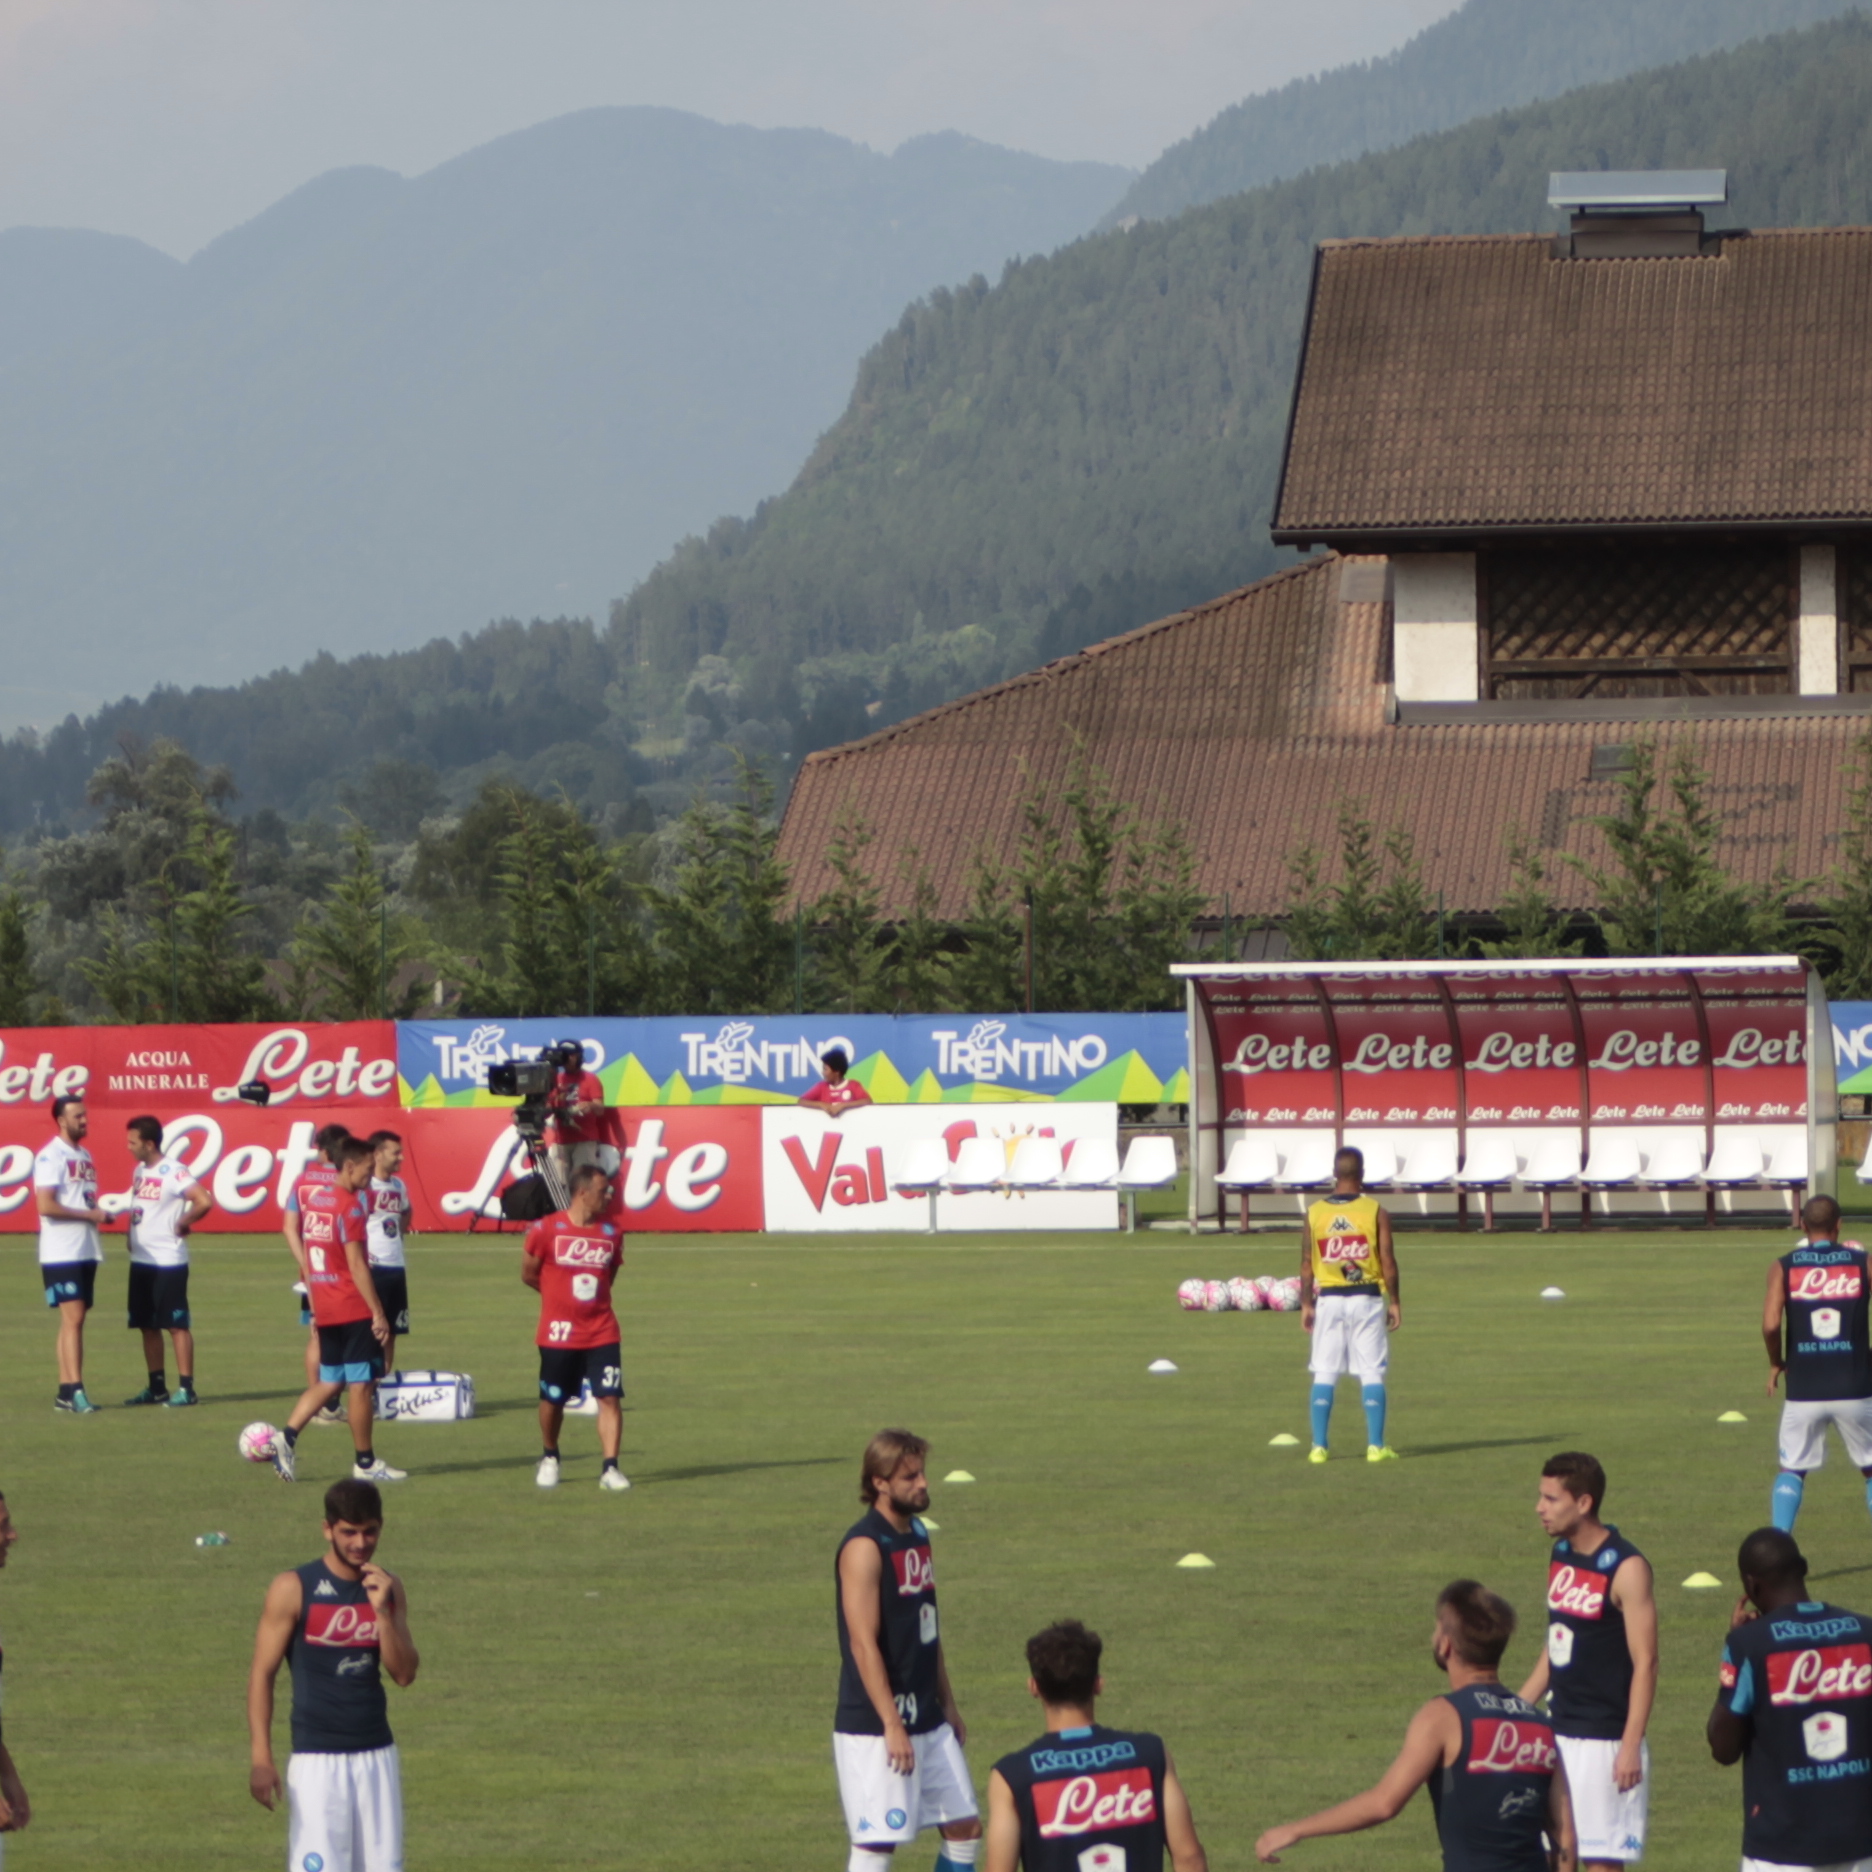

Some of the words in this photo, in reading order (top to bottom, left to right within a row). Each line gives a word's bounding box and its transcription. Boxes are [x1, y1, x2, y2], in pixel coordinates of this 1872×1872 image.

[125, 1050, 192, 1068] ACQUA
[212, 1028, 395, 1105] Lete
[933, 1031, 1107, 1081] TRENTINO
[1222, 1034, 1331, 1074] Lete
[1342, 1032, 1453, 1073] Lete
[1465, 1031, 1577, 1072] Lete
[1588, 1029, 1701, 1071] Lete
[109, 1072, 210, 1090] MINERALE
[1226, 1107, 1259, 1121] Lete
[1263, 1107, 1297, 1121] Lete
[1301, 1107, 1335, 1121] Lete
[1345, 1107, 1379, 1121] Lete
[1383, 1107, 1417, 1121] Lete
[1422, 1106, 1456, 1120] Lete
[1468, 1106, 1502, 1120] Lete
[1506, 1106, 1541, 1120] Lete
[1545, 1105, 1580, 1120] Lete
[1592, 1105, 1626, 1119] Lete
[1630, 1105, 1665, 1119] Lete
[1669, 1104, 1704, 1118] Lete
[1716, 1103, 1750, 1117] Lete
[1755, 1102, 1790, 1117] Lete
[781, 1131, 888, 1214] Val
[1322, 1236, 1369, 1262] Lete
[1790, 1267, 1861, 1299] Lete
[548, 1320, 572, 1342] 37
[602, 1366, 621, 1388] 37
[385, 1387, 444, 1420] Sixtus
[1548, 1565, 1604, 1614] Lete
[1771, 1617, 1862, 1641] Kappa
[1771, 1649, 1872, 1703] Lete
[1030, 1741, 1136, 1773] Kappa
[1469, 1721, 1557, 1771] Lete
[1788, 1766, 1814, 1783] SSC
[1039, 1776, 1154, 1835] Lete
